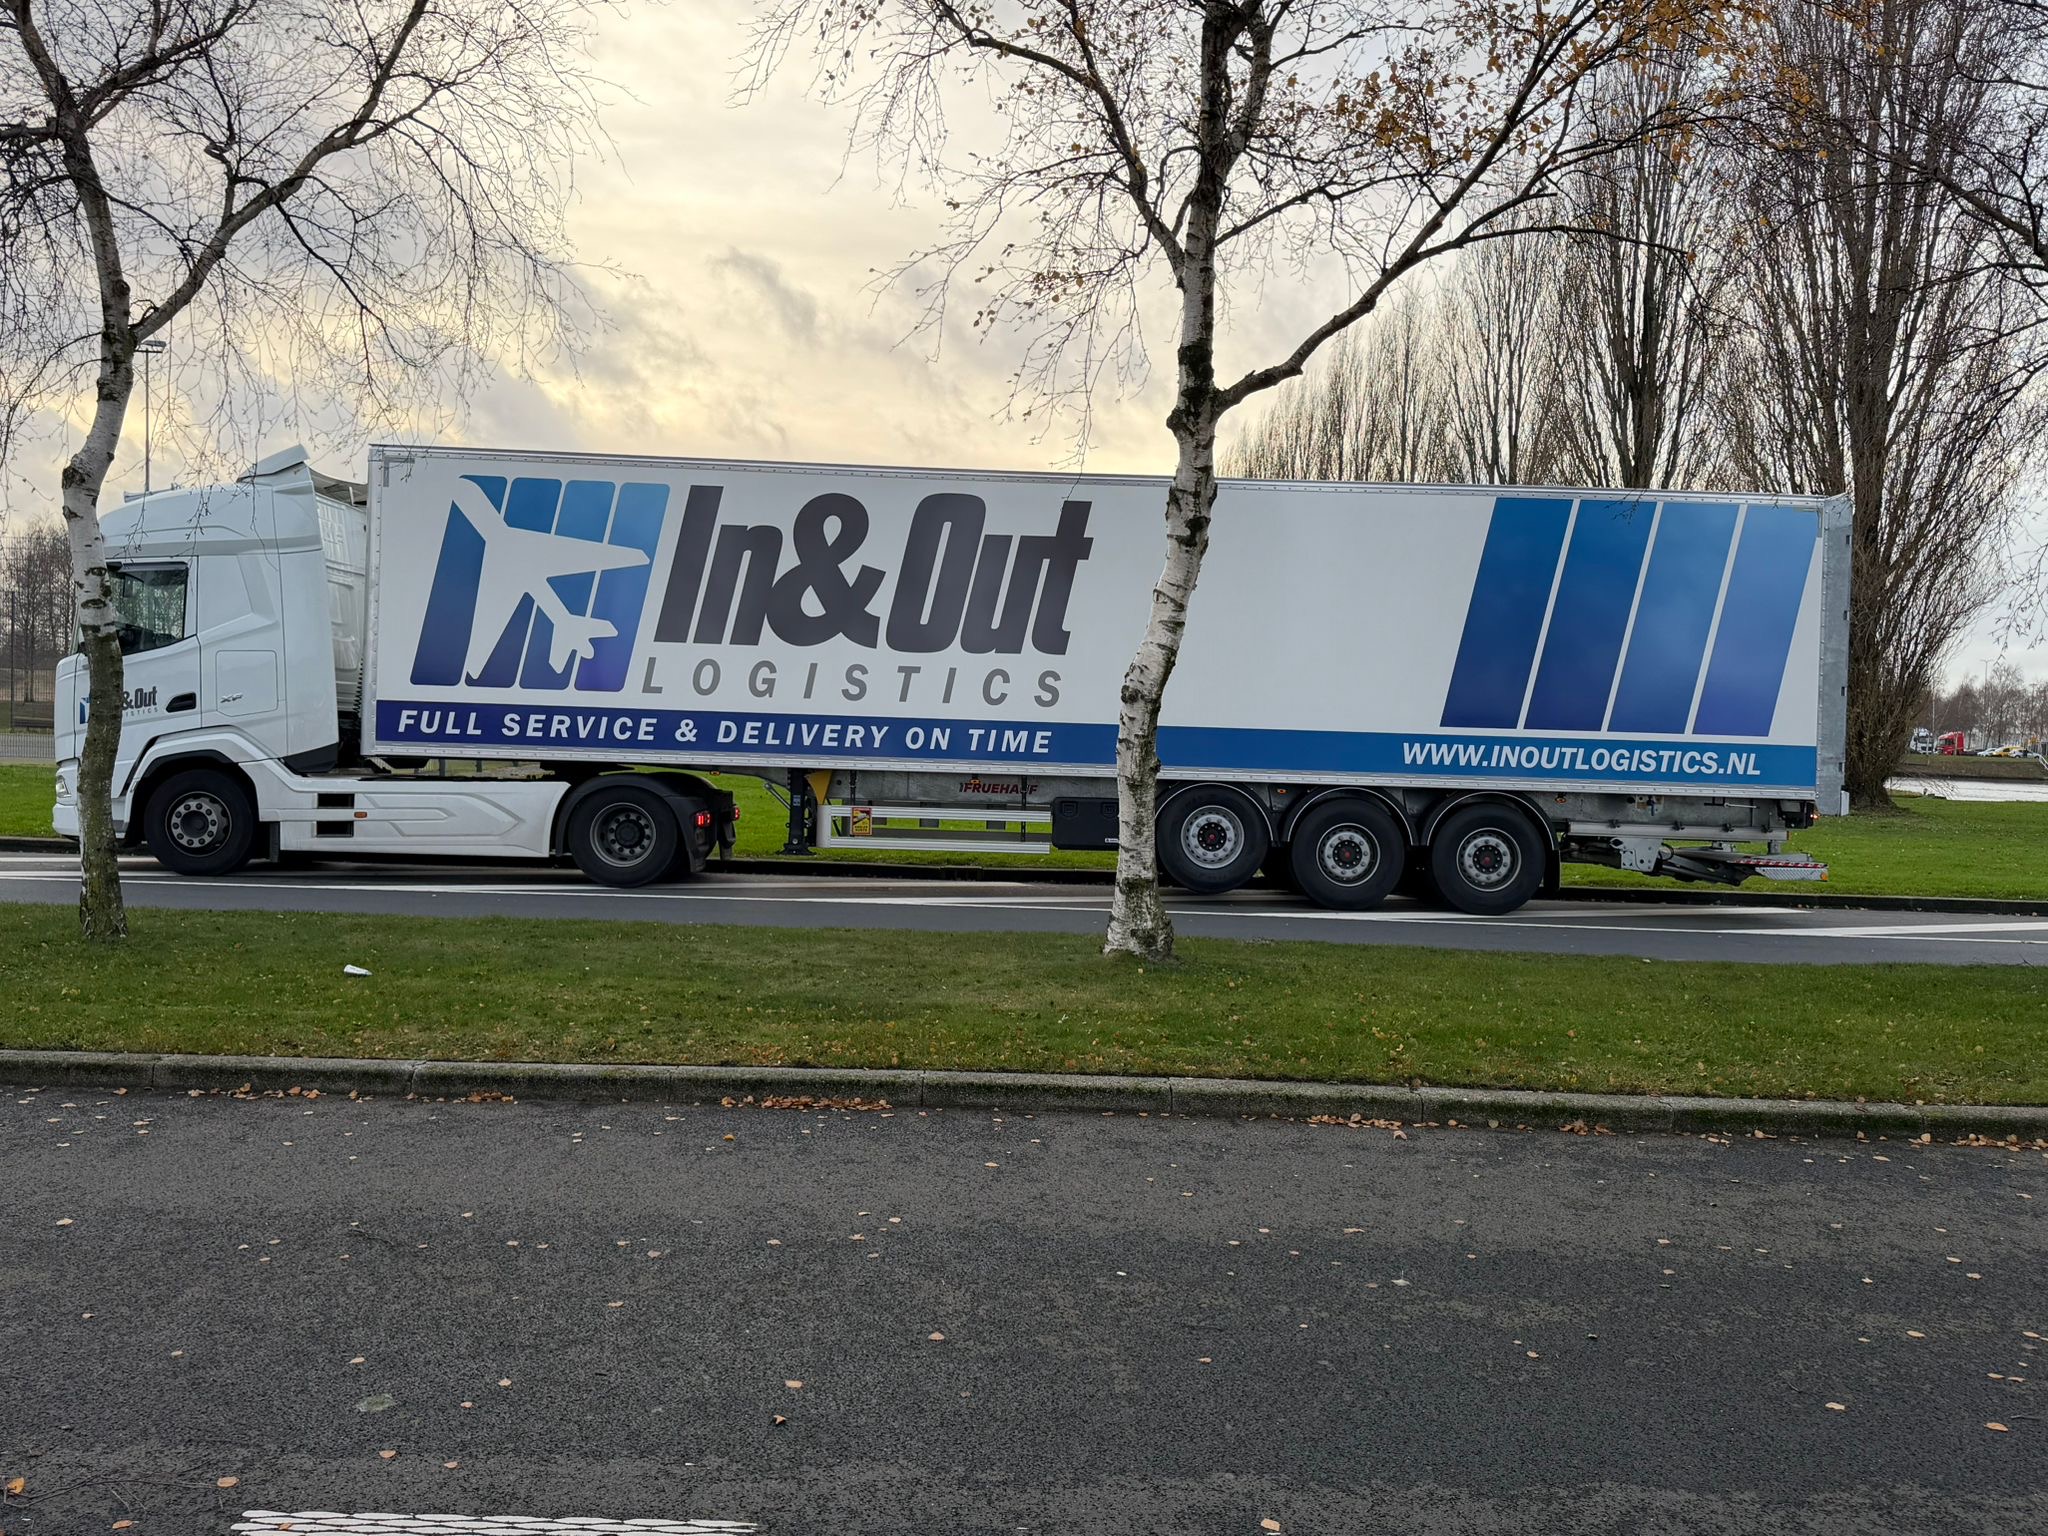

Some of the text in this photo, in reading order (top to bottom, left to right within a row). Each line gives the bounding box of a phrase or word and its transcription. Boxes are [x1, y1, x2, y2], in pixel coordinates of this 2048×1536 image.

[653, 485, 1094, 655] In&Out
[122, 686, 157, 711] &Out
[641, 656, 1063, 708] LOGISTICS
[125, 707, 158, 717] ISTICS
[398, 710, 1052, 753] FULL SERVICE & DELIVERY ON TIME
[1403, 742, 1761, 775] WWW.INOUTLOGISTICS.NL
